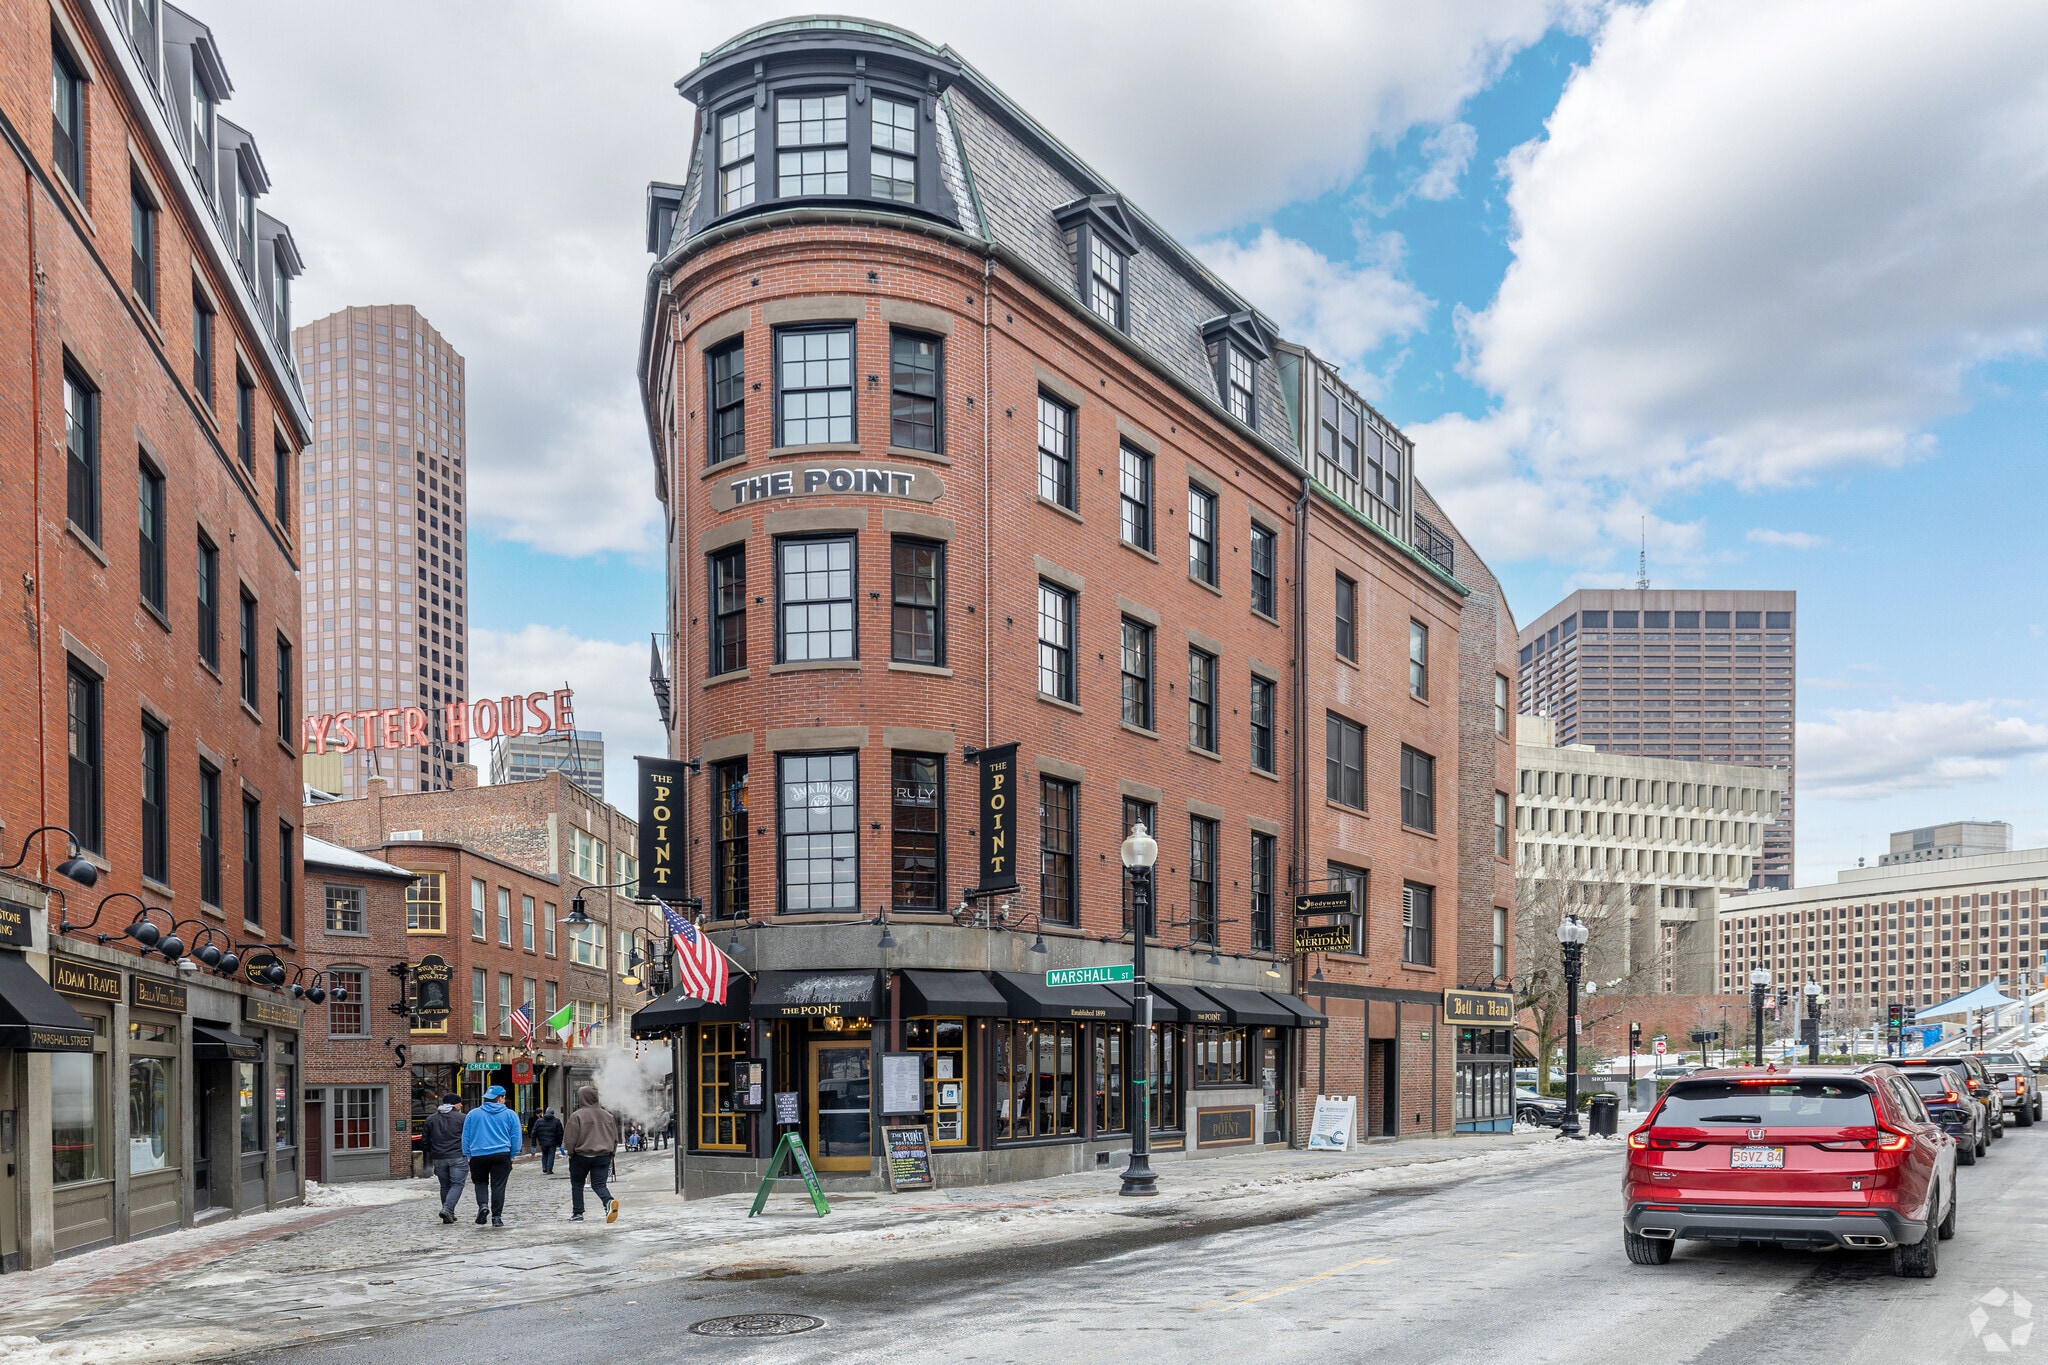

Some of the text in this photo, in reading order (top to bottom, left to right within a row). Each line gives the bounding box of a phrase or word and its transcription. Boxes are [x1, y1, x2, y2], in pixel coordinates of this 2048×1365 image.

[731, 468, 915, 503] THE POINT
[446, 688, 574, 744] HOUSE
[990, 761, 1007, 772] THE
[651, 774, 672, 784] THE
[894, 786, 935, 799] RULY
[991, 774, 1005, 873] POINT
[653, 786, 671, 883] POINT
[0, 909, 21, 924] TONE
[1296, 936, 1350, 948] MERIDIAN
[417, 964, 448, 973] SWARTZ
[57, 967, 119, 995] ADAM TRAVEL
[418, 973, 449, 981] SWARTZ
[1051, 968, 1129, 984] MARSHALL ST
[781, 1003, 841, 1017] THE POINT
[1454, 997, 1509, 1017] Bell in Hand
[1205, 1011, 1221, 1022] POINT
[33, 1032, 92, 1046] 7 MARSHALL STREET
[902, 1129, 922, 1143] POINT
[1212, 1122, 1240, 1137] POINT
[1733, 1151, 1782, 1162] 5GVZ 84
